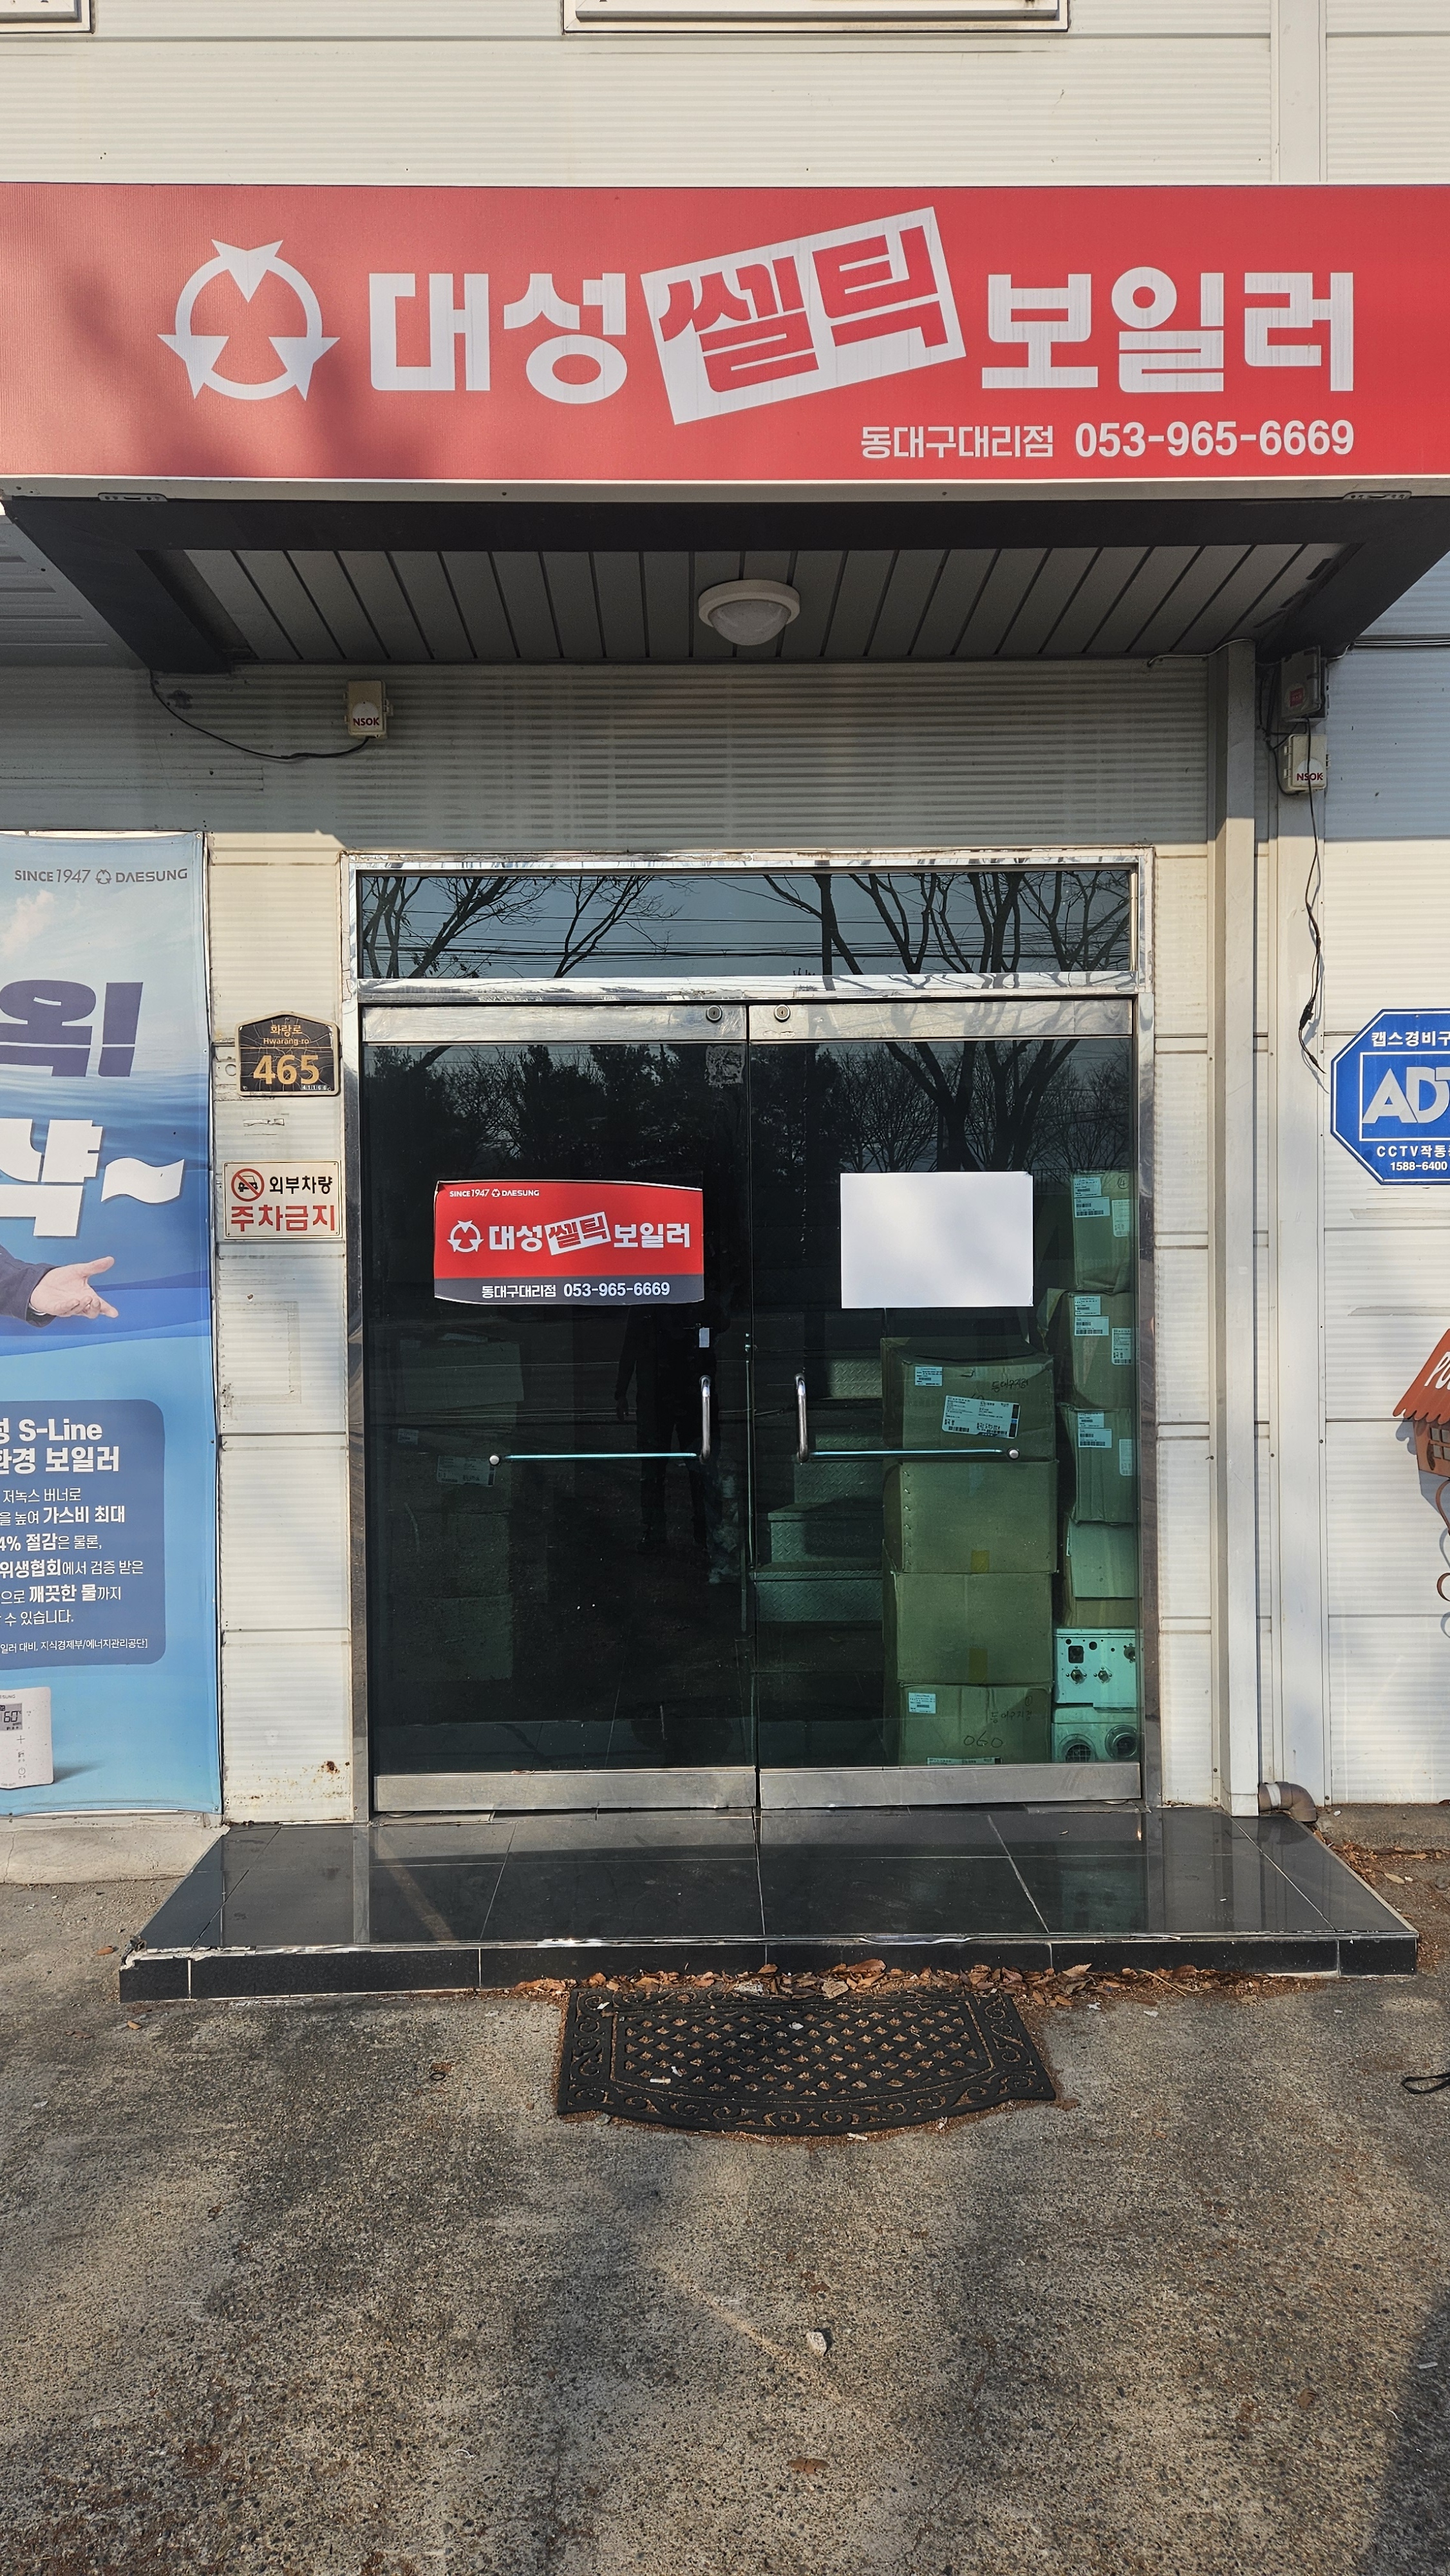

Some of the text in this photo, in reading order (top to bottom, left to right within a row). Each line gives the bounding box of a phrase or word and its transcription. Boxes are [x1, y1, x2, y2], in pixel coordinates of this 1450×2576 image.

[369, 224, 1353, 404] 대성 쎌틱 보일러
[861, 420, 1354, 459] 동대구대리점 053-965-6669
[353, 717, 380, 726] NSOK
[1296, 772, 1323, 781] NSOK
[15, 868, 188, 883] SINCE 1947 DAESUNG
[270, 1025, 303, 1037] 화랑로
[263, 1037, 310, 1046] Hwarang-ro
[253, 1054, 319, 1084] 465
[1376, 1144, 1450, 1158] CCTV작동
[1390, 1160, 1448, 1171] 1588-6400
[269, 1175, 333, 1195] 외부차량
[231, 1204, 335, 1232] 주차금지
[489, 1225, 543, 1252] 대성
[614, 1222, 690, 1248] 보일러
[482, 1282, 670, 1298] 동대구대리점 053-965-6669
[19, 1418, 102, 1441] S-Line
[46, 1446, 119, 1472] 보일러
[3, 1488, 81, 1503] 저녹스 버너로
[15, 1510, 39, 1526] 높여
[43, 1506, 89, 1524] 가스비
[95, 1505, 125, 1523] 최대
[26, 1533, 70, 1551] 절감은
[73, 1535, 102, 1549] 물론,
[91, 1561, 115, 1575] 검증
[119, 1560, 144, 1574] 받은
[29, 1584, 77, 1603] 깨끗한
[81, 1584, 121, 1602] 물까지
[5, 1613, 17, 1627] 수
[21, 1609, 74, 1626] 있습니다.
[19, 1641, 39, 1652] 대비,
